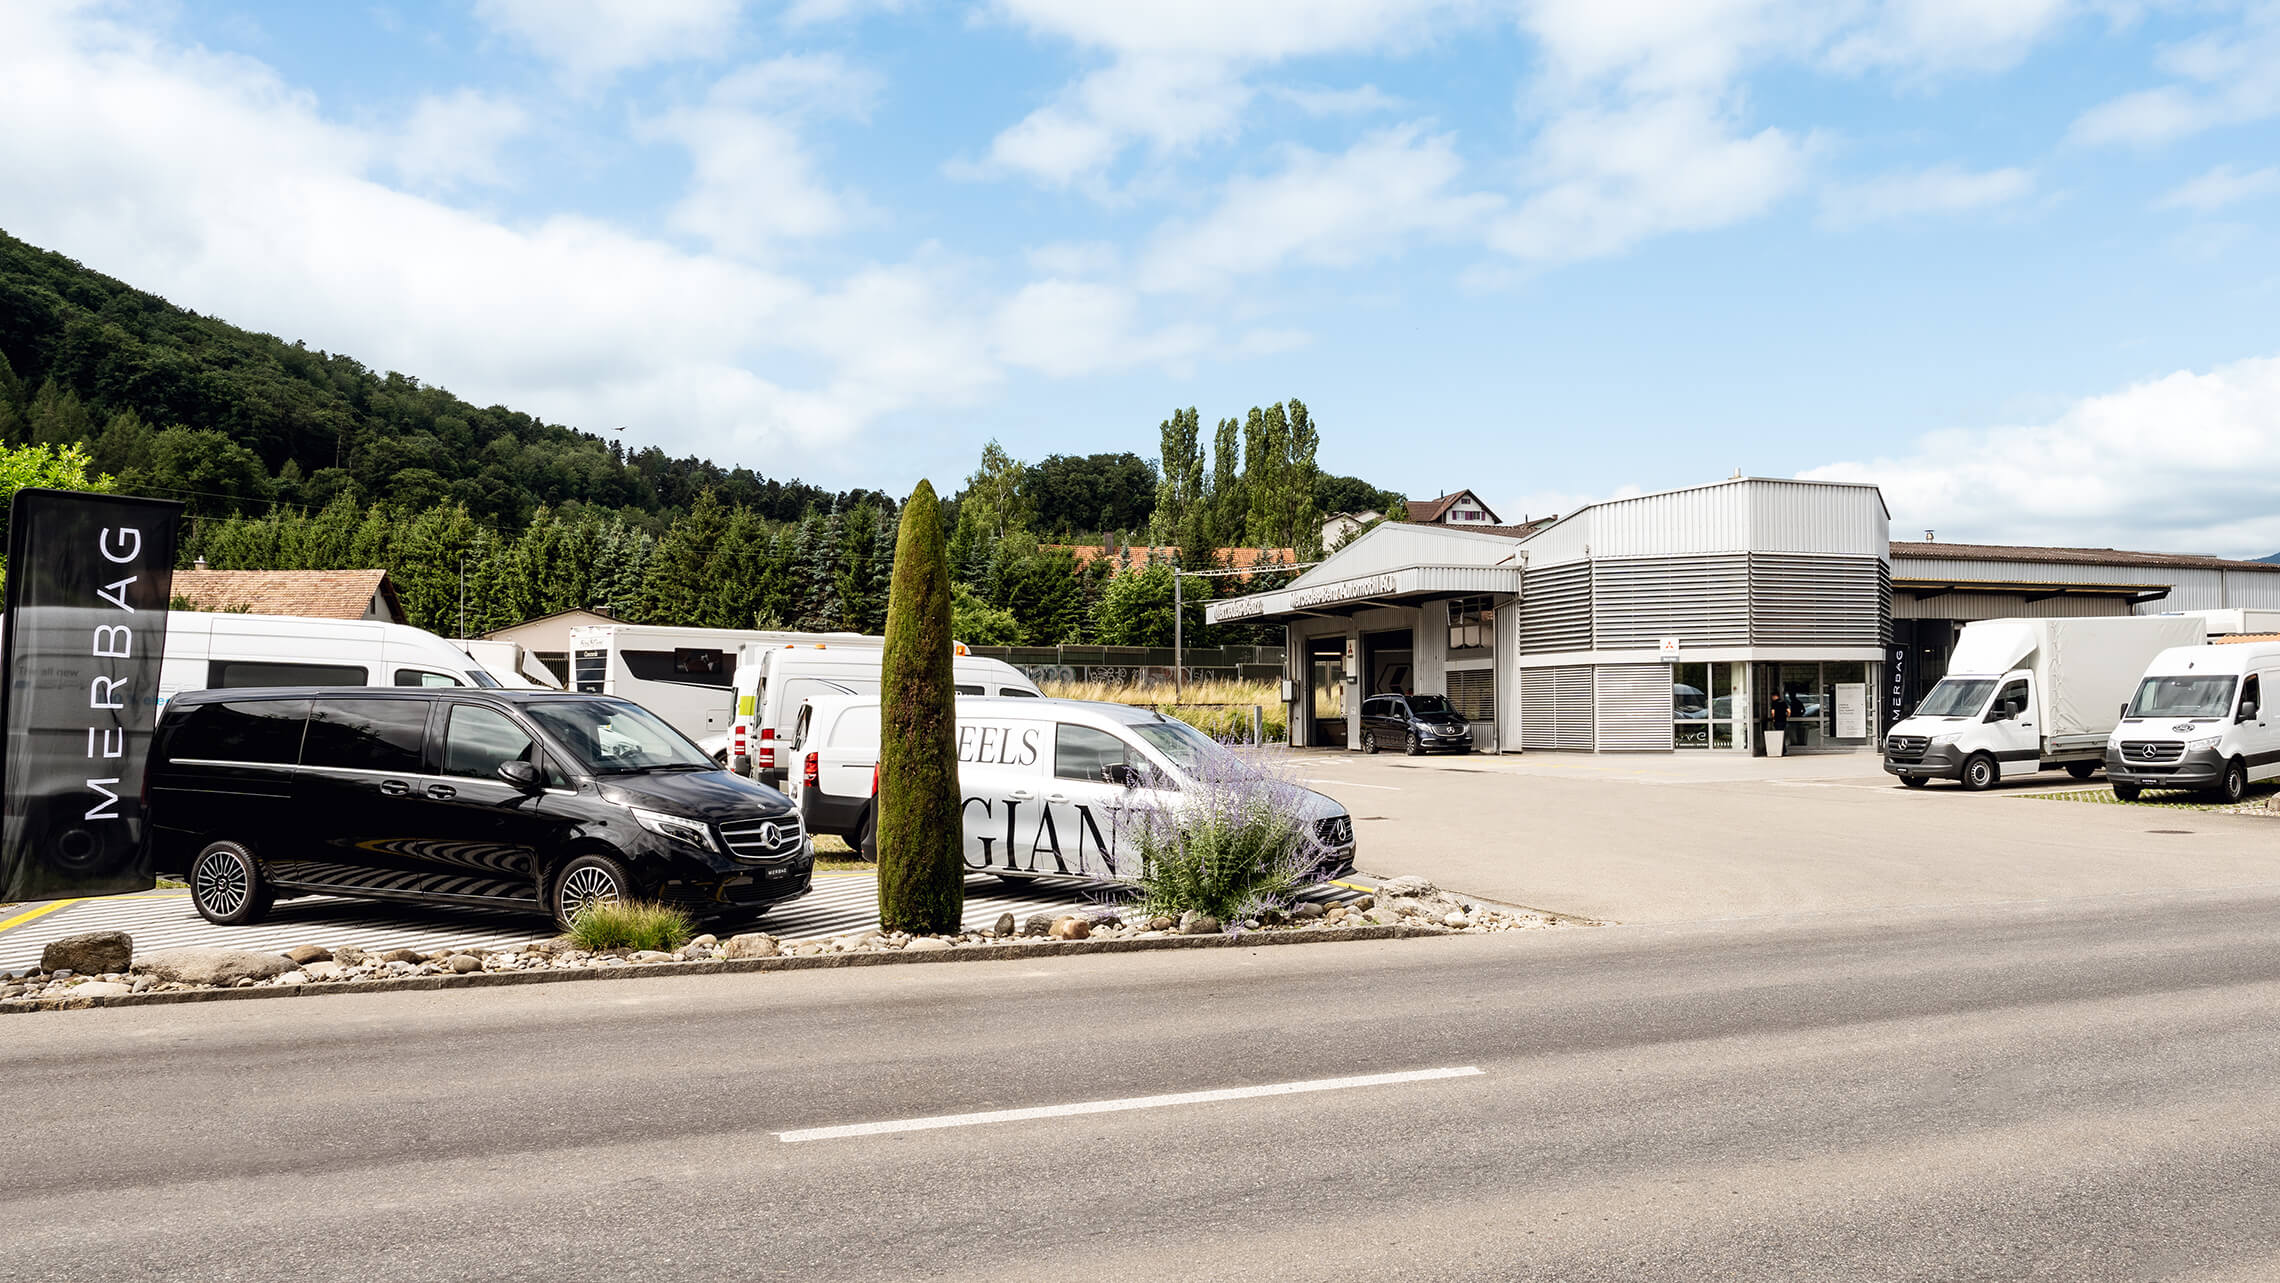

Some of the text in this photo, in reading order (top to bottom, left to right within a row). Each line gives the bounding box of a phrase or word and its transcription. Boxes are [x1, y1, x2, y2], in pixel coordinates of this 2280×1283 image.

[1340, 576, 1379, 600] Automobil
[85, 527, 142, 821] MERBAG
[1892, 650, 1904, 721] MERBAG
